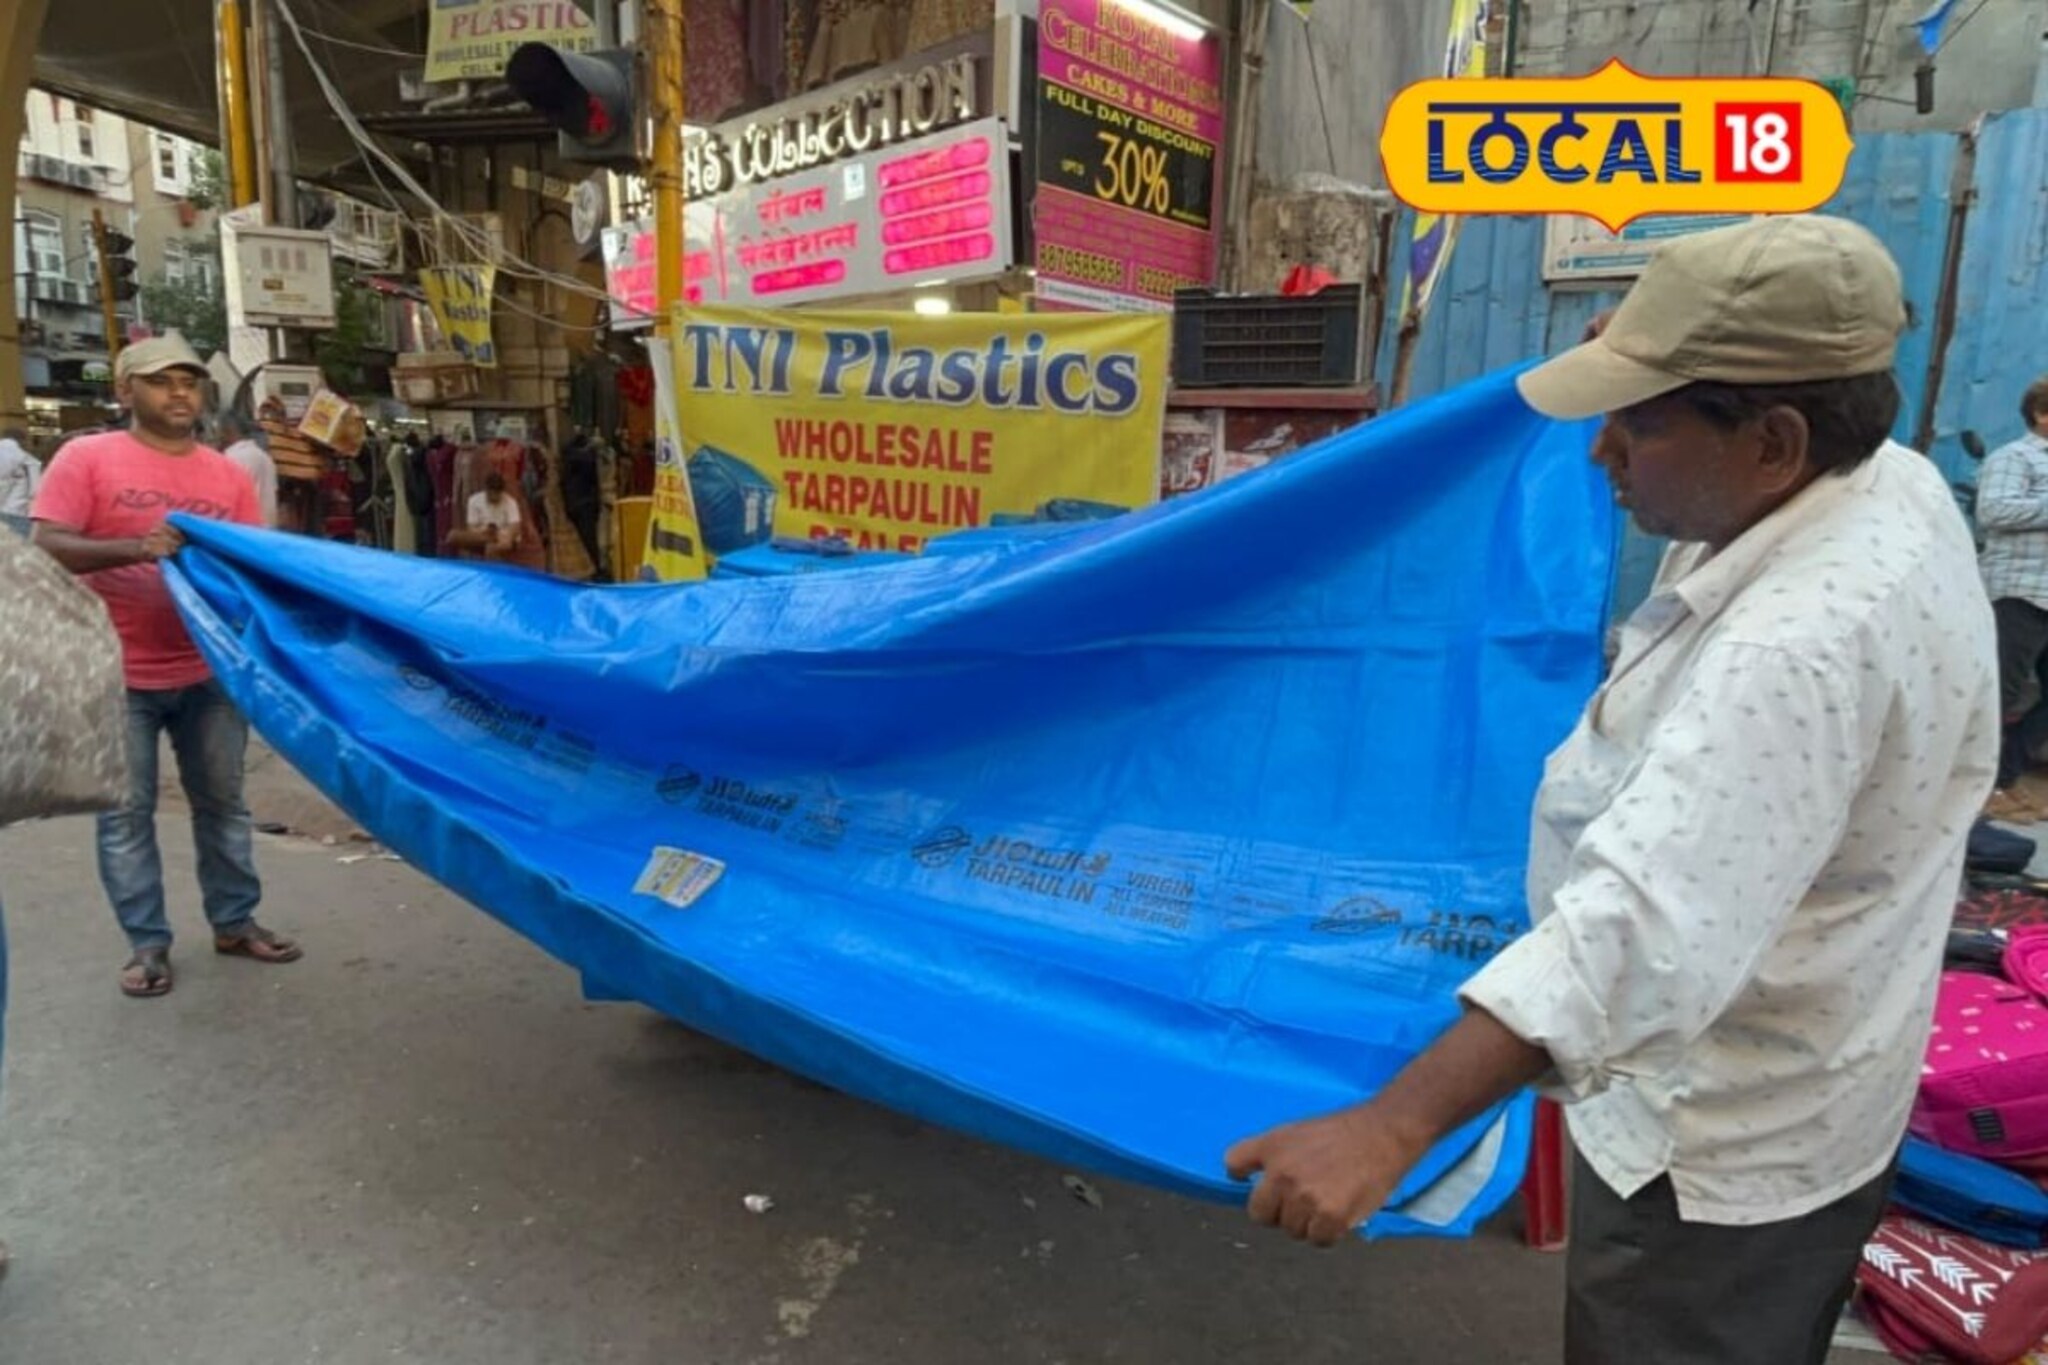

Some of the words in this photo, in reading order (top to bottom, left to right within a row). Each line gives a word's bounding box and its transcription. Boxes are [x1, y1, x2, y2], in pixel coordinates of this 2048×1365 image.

[732, 53, 975, 182] COLLECTION
[1046, 85, 1093, 115] FULL
[1097, 104, 1133, 129] DAY
[1136, 120, 1213, 159] DISCOUNT
[1067, 63, 1129, 103] CAKES
[1152, 98, 1198, 131] MORE
[1095, 131, 1169, 214] 30%
[684, 325, 794, 393] TNI
[817, 330, 1139, 414] Plastics
[775, 418, 993, 474] WHOLESALE
[783, 472, 981, 528] TARPAULIN
[964, 857, 1096, 904] TARPAULIN
[1128, 871, 1194, 898] VIRGIN
[1400, 925, 1511, 961] TARP
